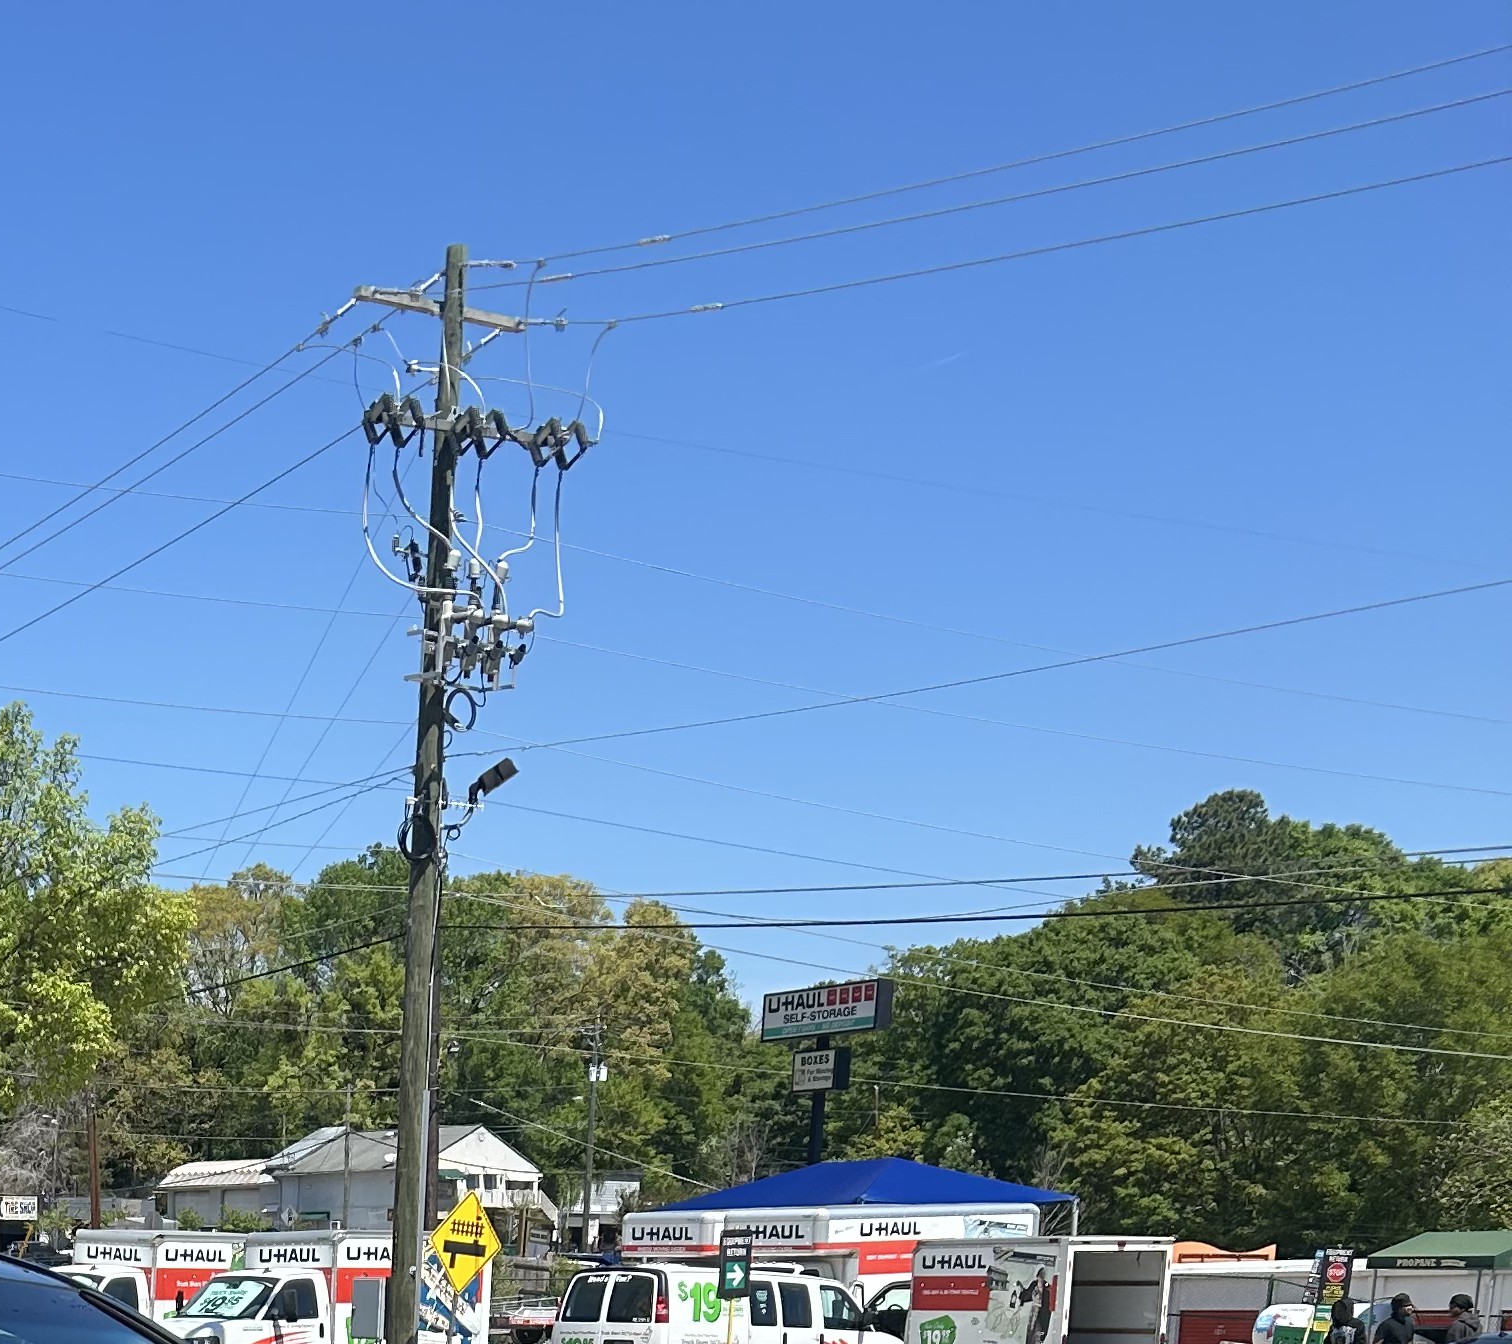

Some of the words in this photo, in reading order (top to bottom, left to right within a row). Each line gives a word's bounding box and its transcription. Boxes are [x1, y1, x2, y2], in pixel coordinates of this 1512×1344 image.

[769, 991, 824, 1013] U-HAUL
[783, 1006, 857, 1024] SELF-STORAGE
[801, 1054, 830, 1067] BOXES
[632, 1226, 693, 1241] U-HAUL
[747, 1224, 805, 1240] -HAUL
[860, 1221, 921, 1236] U-HAUL
[87, 1246, 142, 1262] U-HAUL
[165, 1248, 226, 1263] U-HAUL
[259, 1248, 320, 1263] U-HAUL
[346, 1246, 392, 1261] U-HA
[922, 1254, 986, 1269] U-HAUL
[1396, 1259, 1437, 1267] PROPANE
